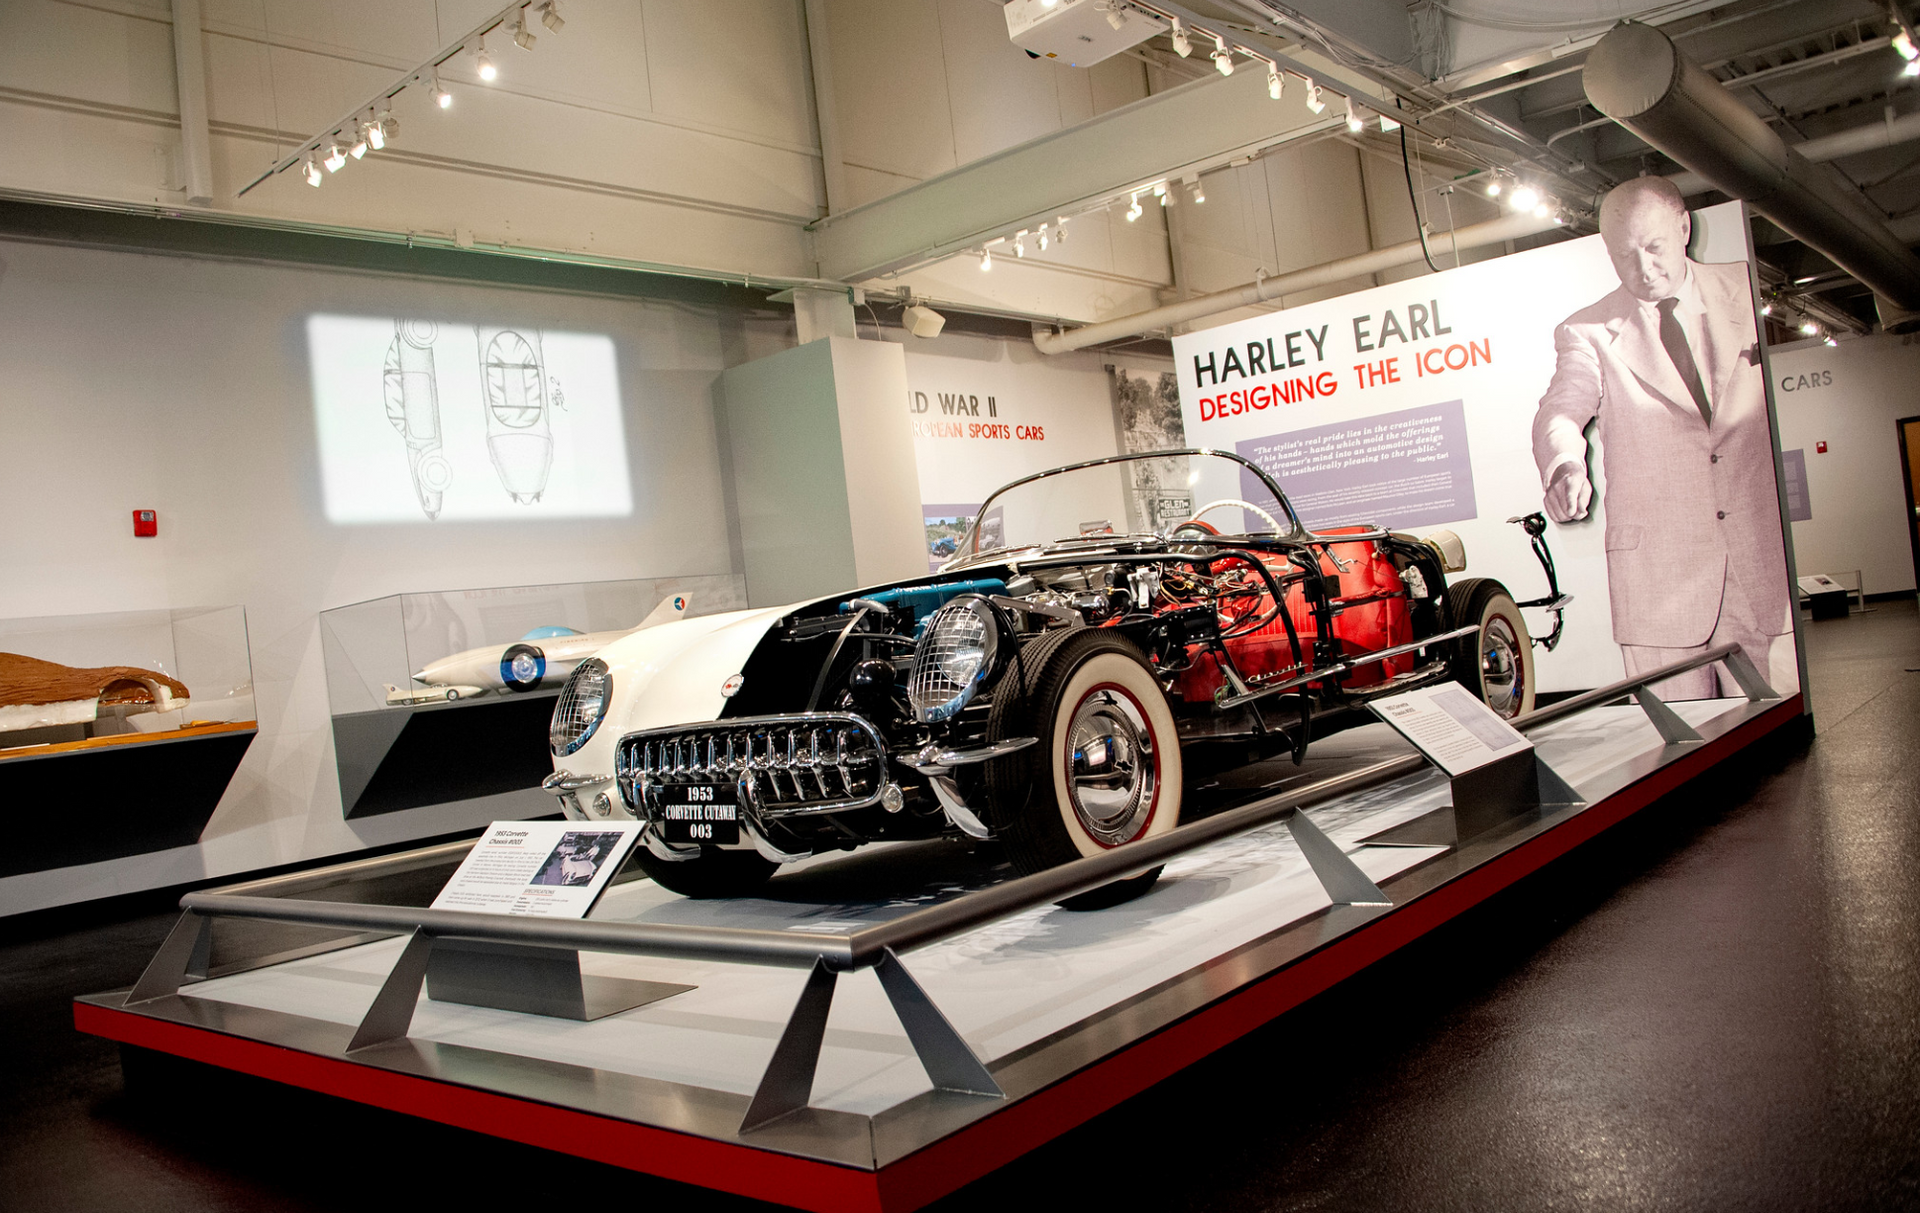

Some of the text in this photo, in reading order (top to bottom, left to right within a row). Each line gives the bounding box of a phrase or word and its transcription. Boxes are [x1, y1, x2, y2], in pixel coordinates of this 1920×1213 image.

[1193, 299, 1452, 389] HARLEY EARL
[1199, 337, 1492, 422] DESIGNING THE ICON
[1781, 370, 1833, 392] CARS
[937, 393, 980, 417] WAR
[988, 396, 997, 418] II
[968, 423, 1010, 440] SPORTS
[1015, 425, 1044, 440] CARS
[1305, 437, 1321, 446] real
[1323, 432, 1345, 444] pride
[1347, 430, 1362, 439] lies
[1364, 426, 1372, 435] in
[1374, 424, 1388, 433] the
[1390, 415, 1442, 431] creativeness
[1255, 457, 1264, 465] of
[1264, 453, 1276, 462] his
[1278, 449, 1302, 460] hands
[1310, 443, 1335, 454] hands
[1336, 438, 1361, 450] which
[1363, 435, 1384, 444] mold
[1386, 432, 1400, 441] the
[1401, 425, 1440, 438] offerings
[1313, 453, 1333, 463] mind
[1335, 449, 1352, 459] into
[1354, 448, 1365, 456] an
[1367, 440, 1414, 453] automotive
[1416, 434, 1443, 446] design
[1282, 468, 1289, 477] is
[1291, 461, 1342, 476] aesthetically
[1344, 454, 1378, 467] pleasing
[1381, 451, 1390, 460] to
[1391, 449, 1406, 458] the
[1416, 455, 1436, 464] Harley
[1437, 452, 1448, 461] Earl
[687, 786, 714, 801] 1953
[665, 805, 736, 820] CORVETTE CUTAWAY
[690, 824, 712, 838] 003
